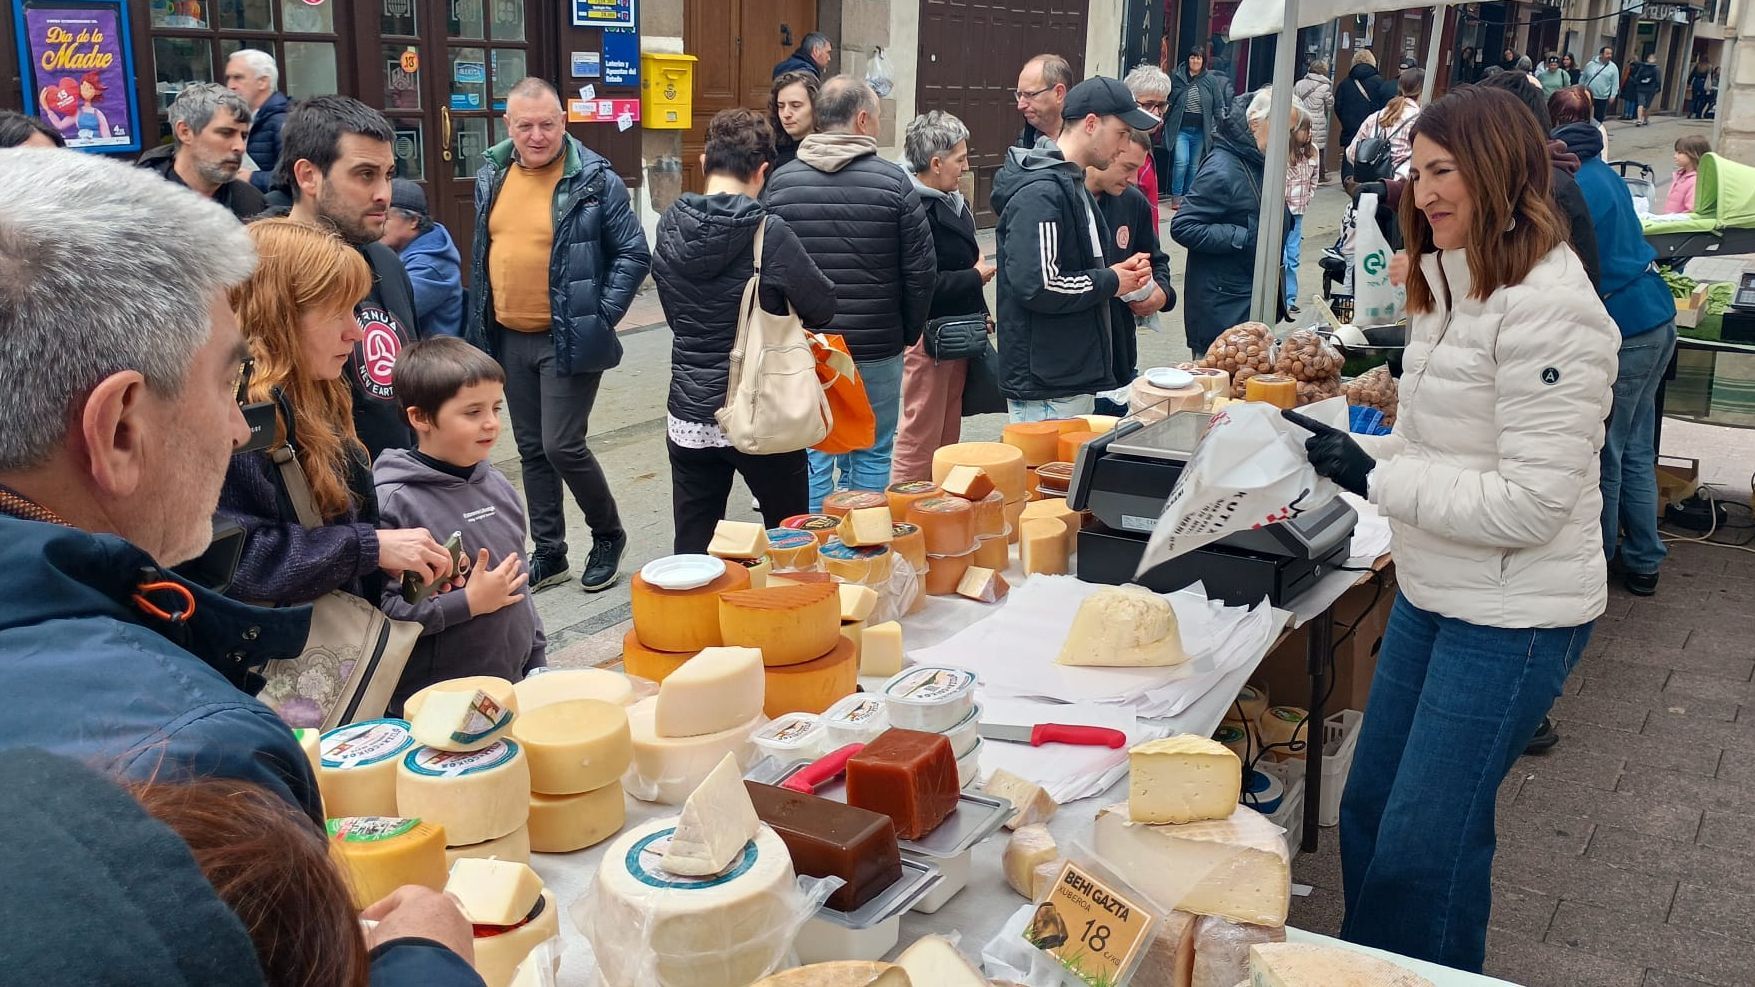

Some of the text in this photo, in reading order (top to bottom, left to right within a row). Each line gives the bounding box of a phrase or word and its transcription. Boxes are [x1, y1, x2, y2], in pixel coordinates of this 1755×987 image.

[76, 28, 90, 43] de
[91, 28, 104, 43] la
[41, 42, 113, 71] Madre
[372, 385, 394, 397] EART
[1063, 870, 1130, 923] BEHI GAZTA
[1080, 919, 1111, 952] 18
